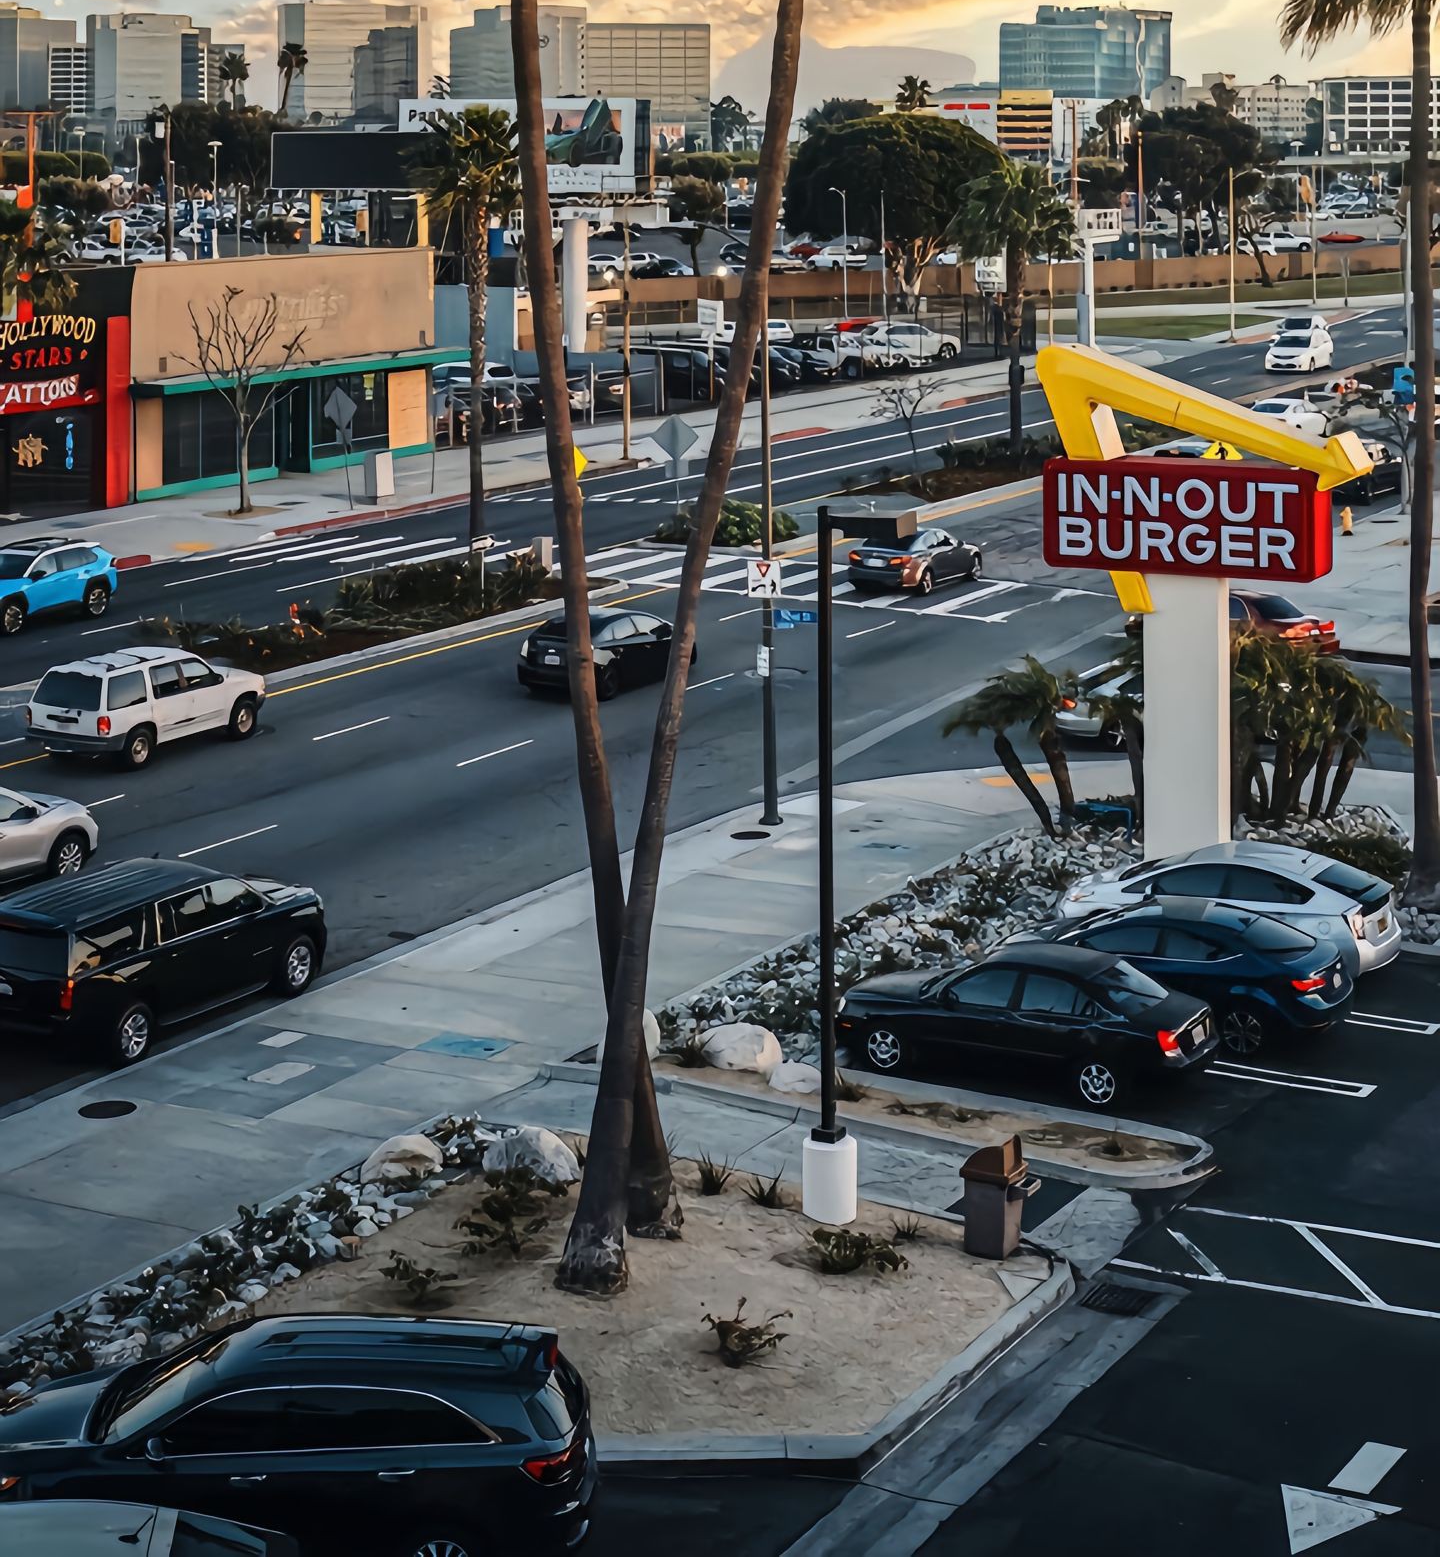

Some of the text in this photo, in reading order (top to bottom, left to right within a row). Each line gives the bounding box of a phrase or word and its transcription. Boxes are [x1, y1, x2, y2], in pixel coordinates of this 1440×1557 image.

[0, 315, 96, 350] HOLLYWOOD
[10, 346, 72, 370] STARS
[1058, 516, 1296, 570] BURGER
